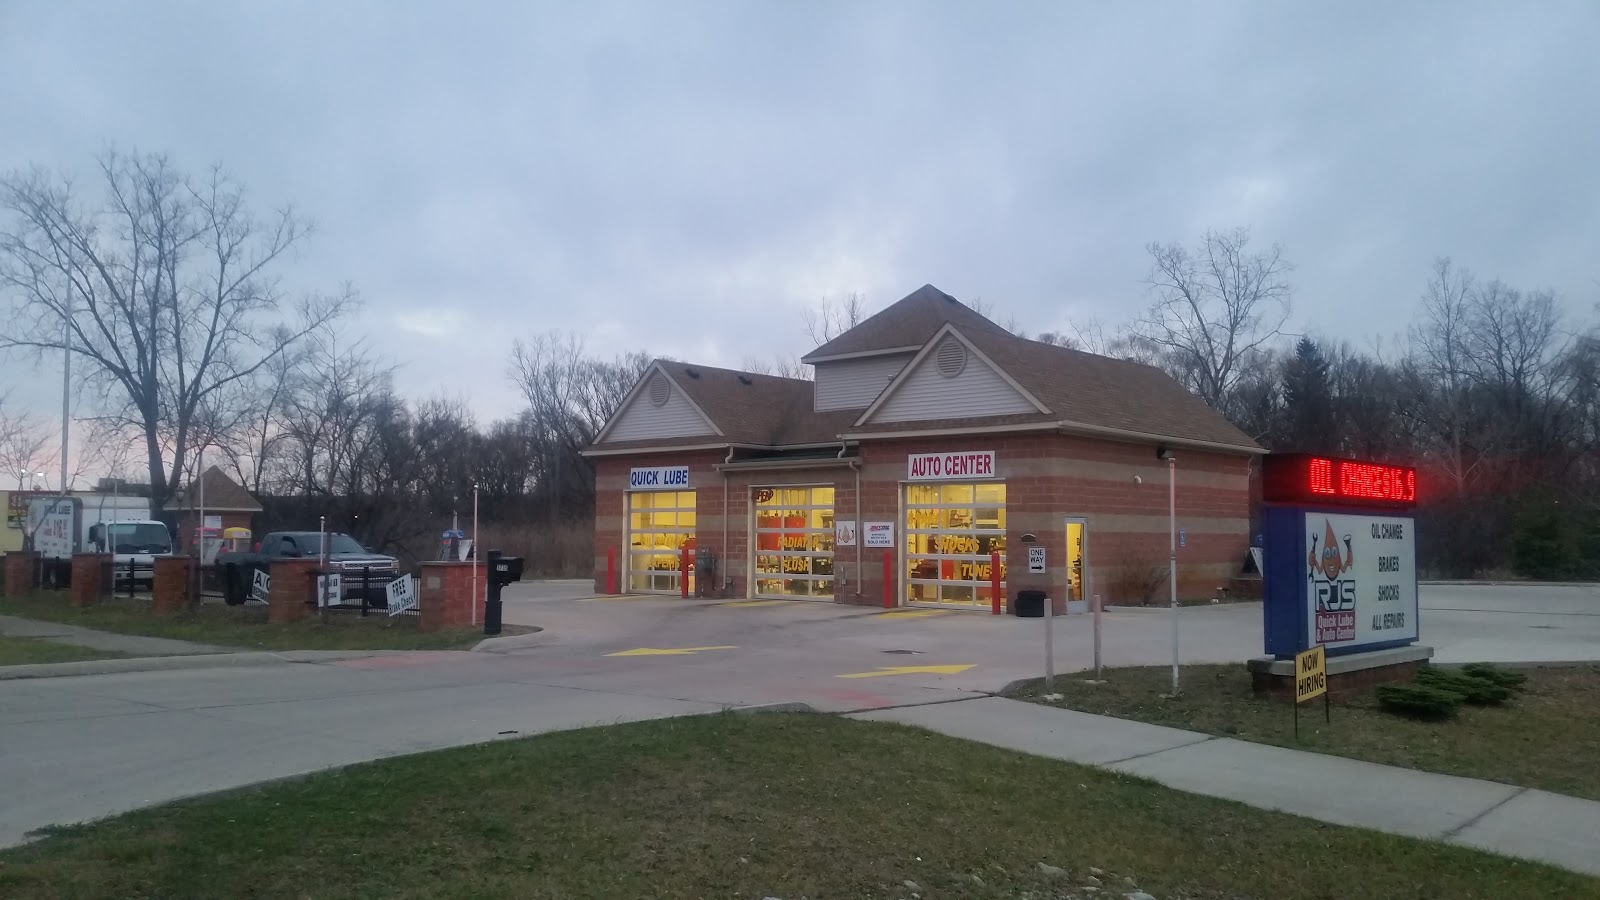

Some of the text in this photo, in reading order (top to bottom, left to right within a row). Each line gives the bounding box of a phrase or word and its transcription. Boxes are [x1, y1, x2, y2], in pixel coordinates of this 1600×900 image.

[911, 454, 991, 476] AUTO CENTER
[631, 469, 688, 486] QUICK LUBE
[1310, 458, 1336, 493] OIL
[752, 489, 773, 502] PEN
[1372, 523, 1403, 540] OIL CHANGE
[777, 536, 819, 549] RADIATR
[934, 536, 980, 553] SHOCKS
[962, 562, 1006, 578] TUNE-P
[1378, 556, 1399, 573] BRAKES
[391, 578, 406, 599] FREE
[1315, 579, 1356, 613] RJS
[1378, 584, 1399, 601] SHOCKS
[1318, 614, 1354, 629] Quick Lube
[1372, 612, 1405, 630] ALL REPAIRS
[1322, 628, 1336, 641] Auto
[1336, 627, 1355, 640] Center
[1302, 651, 1319, 673] NOW
[1298, 671, 1324, 697] HIRING
